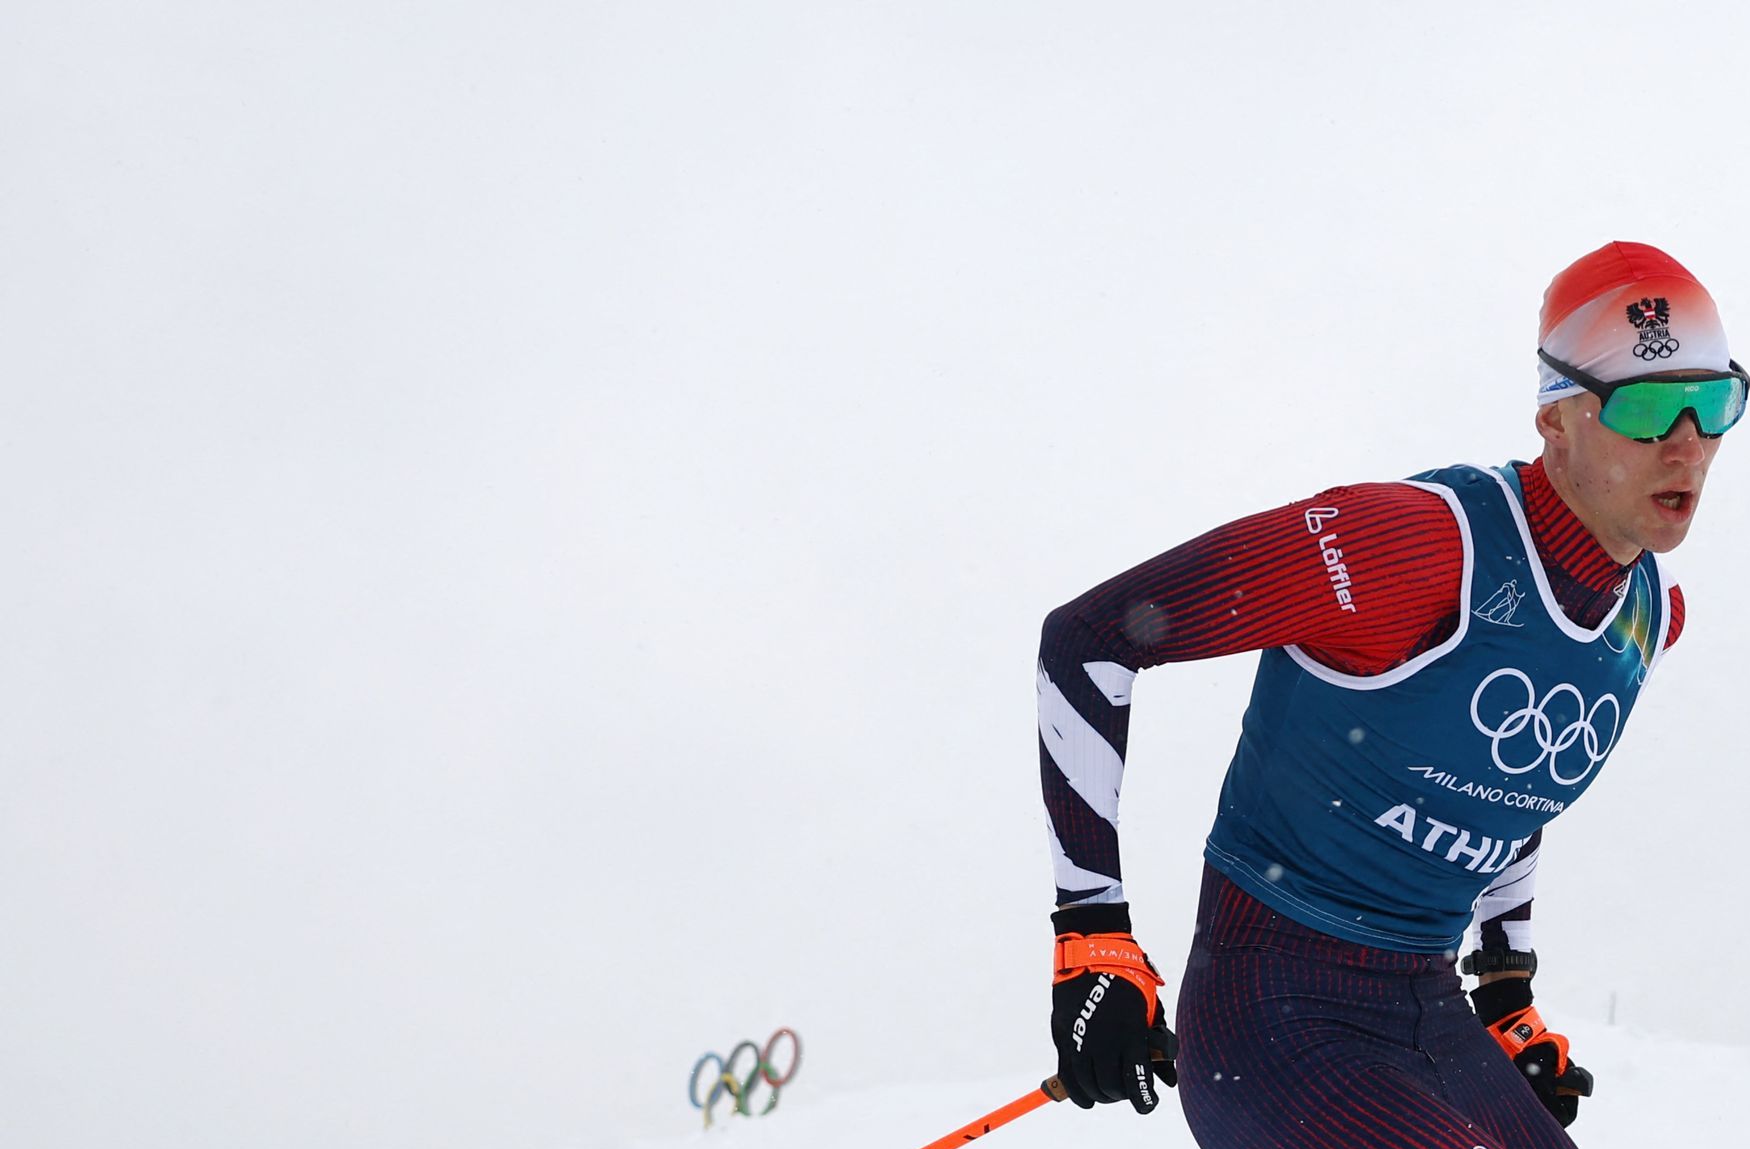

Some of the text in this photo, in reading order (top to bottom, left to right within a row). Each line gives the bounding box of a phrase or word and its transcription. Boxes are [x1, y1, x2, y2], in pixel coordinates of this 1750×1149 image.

[1639, 329, 1670, 341] AUSTRIA
[1319, 533, 1357, 613] Löffler
[1407, 766, 1566, 813] MILANO CORTINA
